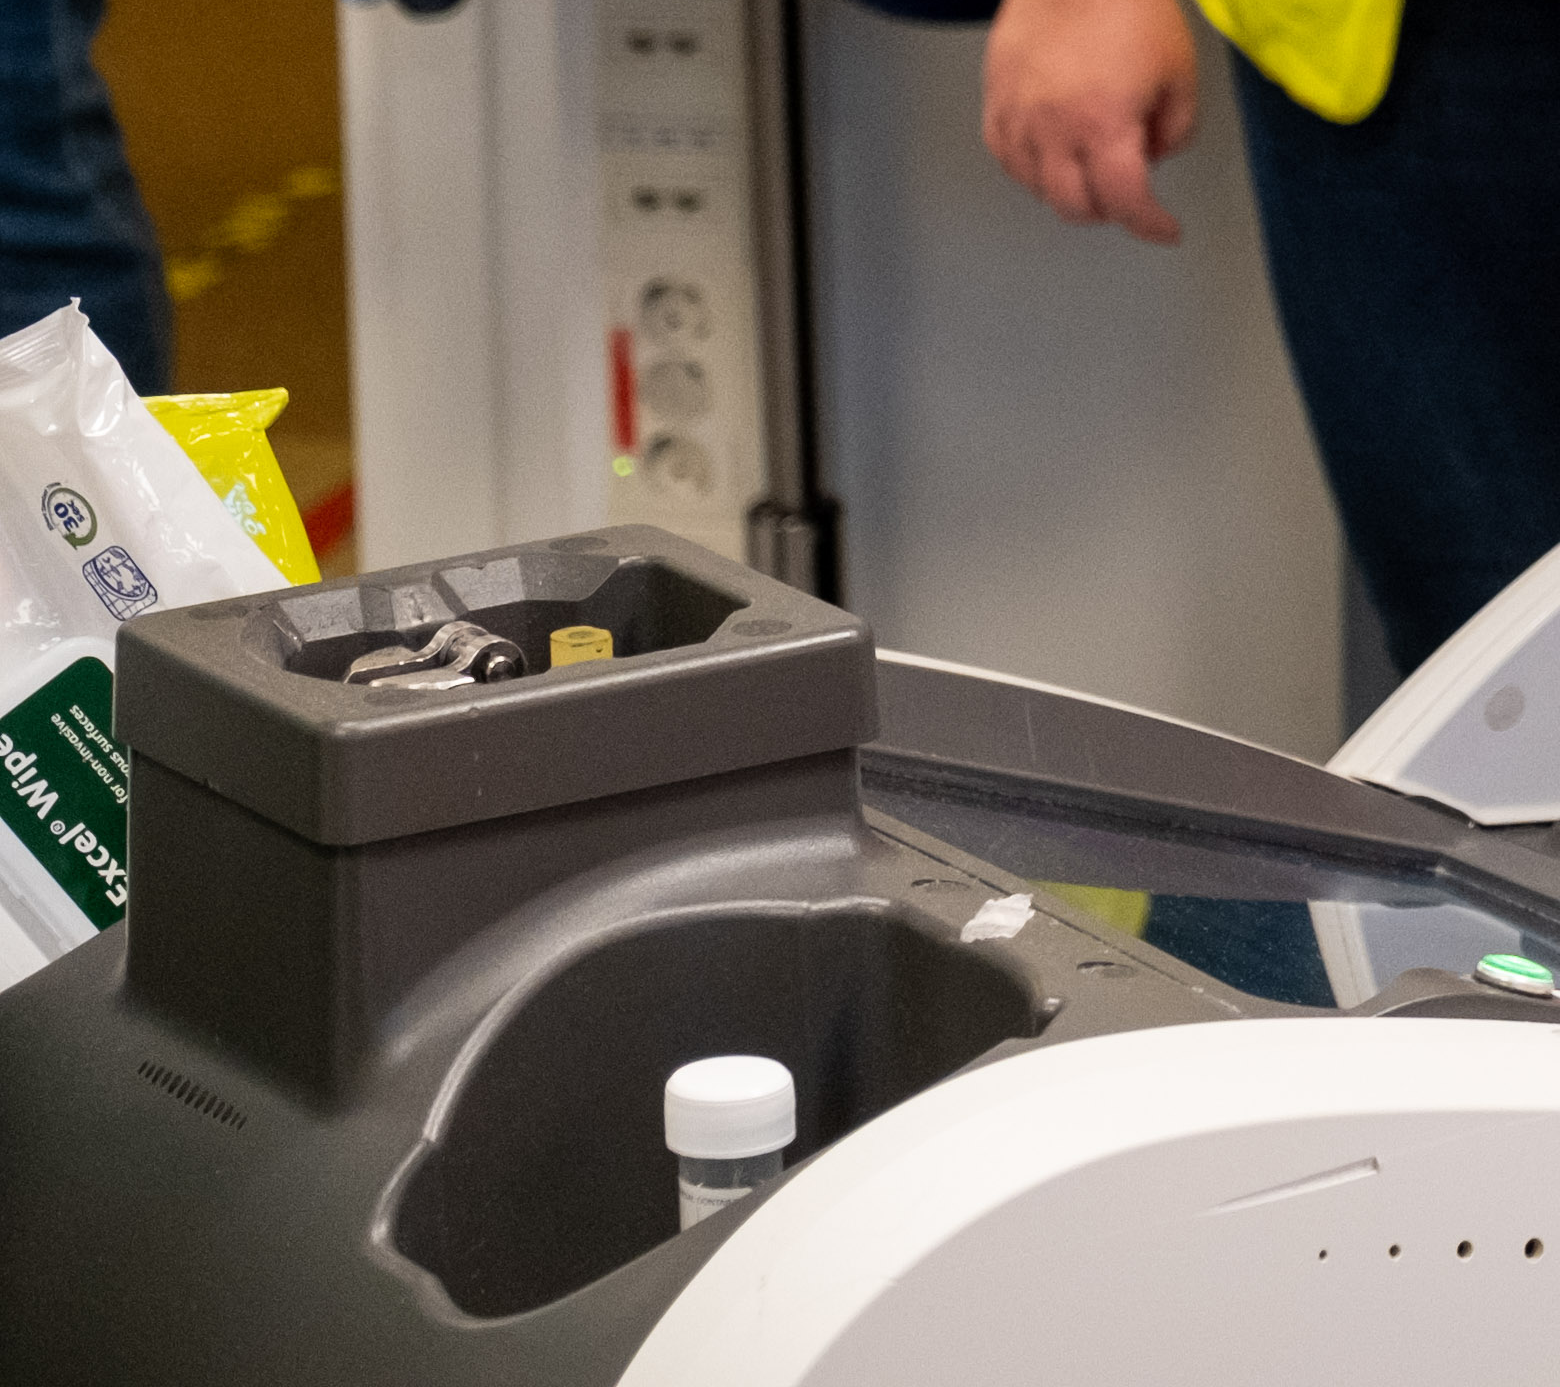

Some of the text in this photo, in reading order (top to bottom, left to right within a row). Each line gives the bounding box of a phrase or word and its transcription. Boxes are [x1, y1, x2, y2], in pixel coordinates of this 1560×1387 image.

[53, 502, 79, 533] 30
[68, 499, 85, 524] sec
[69, 704, 113, 754] surfaces
[50, 712, 129, 804] for non-invasive
